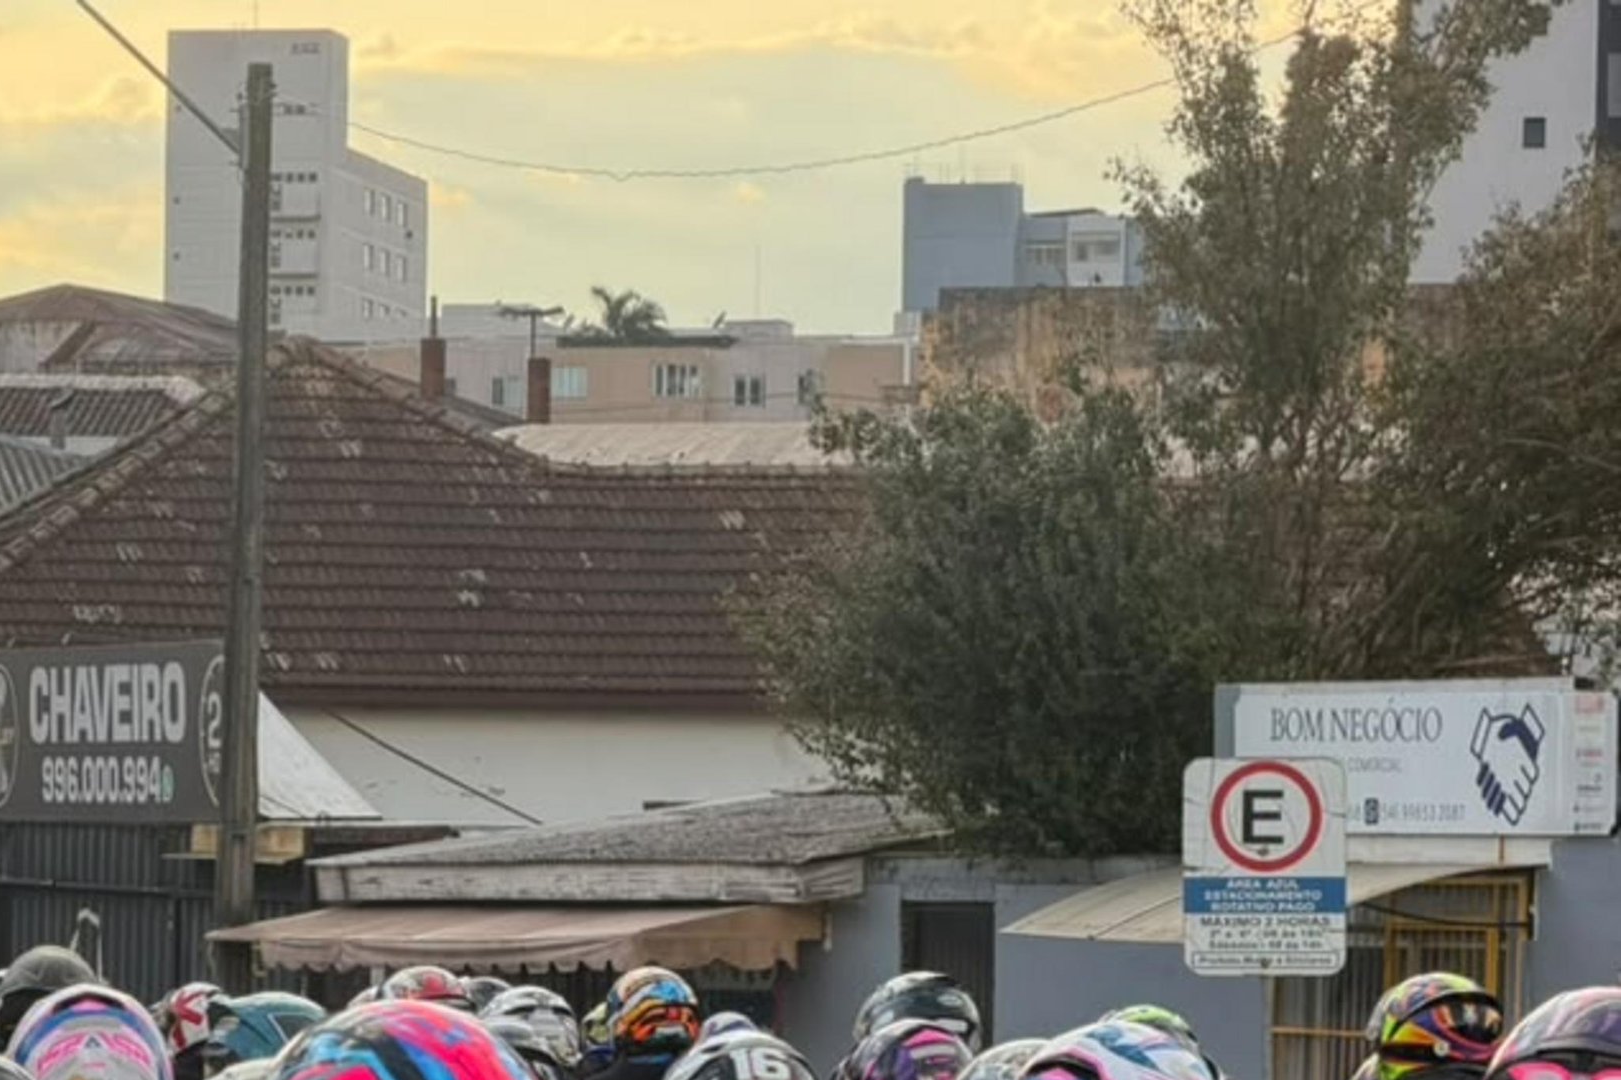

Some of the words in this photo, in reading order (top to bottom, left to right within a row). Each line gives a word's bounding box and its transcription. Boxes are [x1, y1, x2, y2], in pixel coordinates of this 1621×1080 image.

[29, 661, 187, 744] CHAVEIRO
[207, 692, 222, 750] 2
[1270, 707, 1324, 743] BOM
[1328, 697, 1444, 743] NEGÓCIO
[41, 755, 162, 803] 996.000.994
[1242, 789, 1284, 844] E
[1203, 889, 1323, 901] ESTACIONAMENTO
[1210, 901, 1275, 912] ROTATIVO
[1277, 901, 1316, 912] PAGO
[1277, 916, 1331, 926] HORAS
